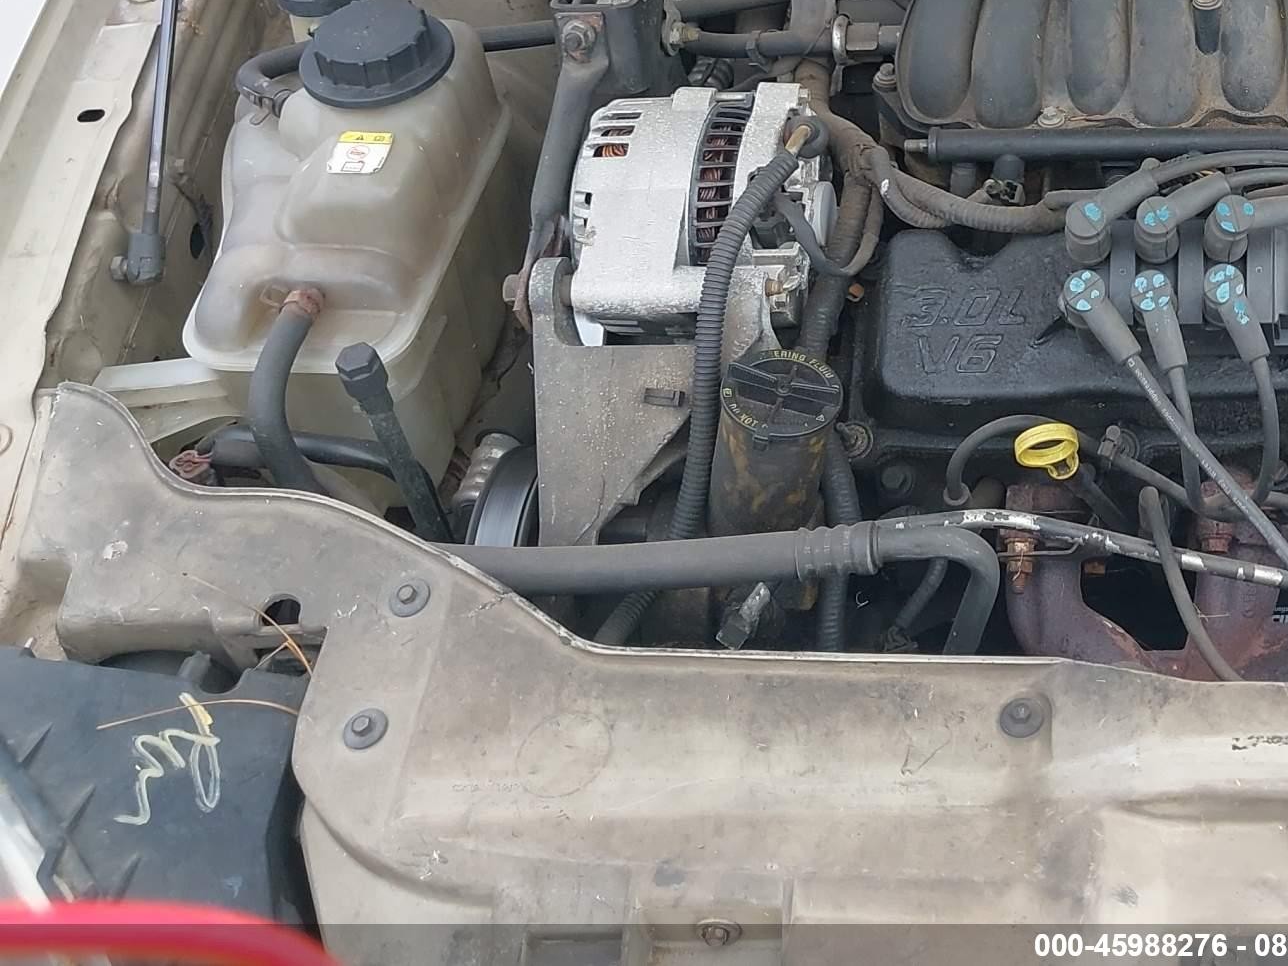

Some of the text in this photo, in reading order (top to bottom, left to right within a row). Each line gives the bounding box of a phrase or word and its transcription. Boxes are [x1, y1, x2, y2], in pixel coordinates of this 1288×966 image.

[900, 287, 1026, 327] 3.0L
[808, 358, 835, 379] FLUID
[916, 333, 1004, 375] V6
